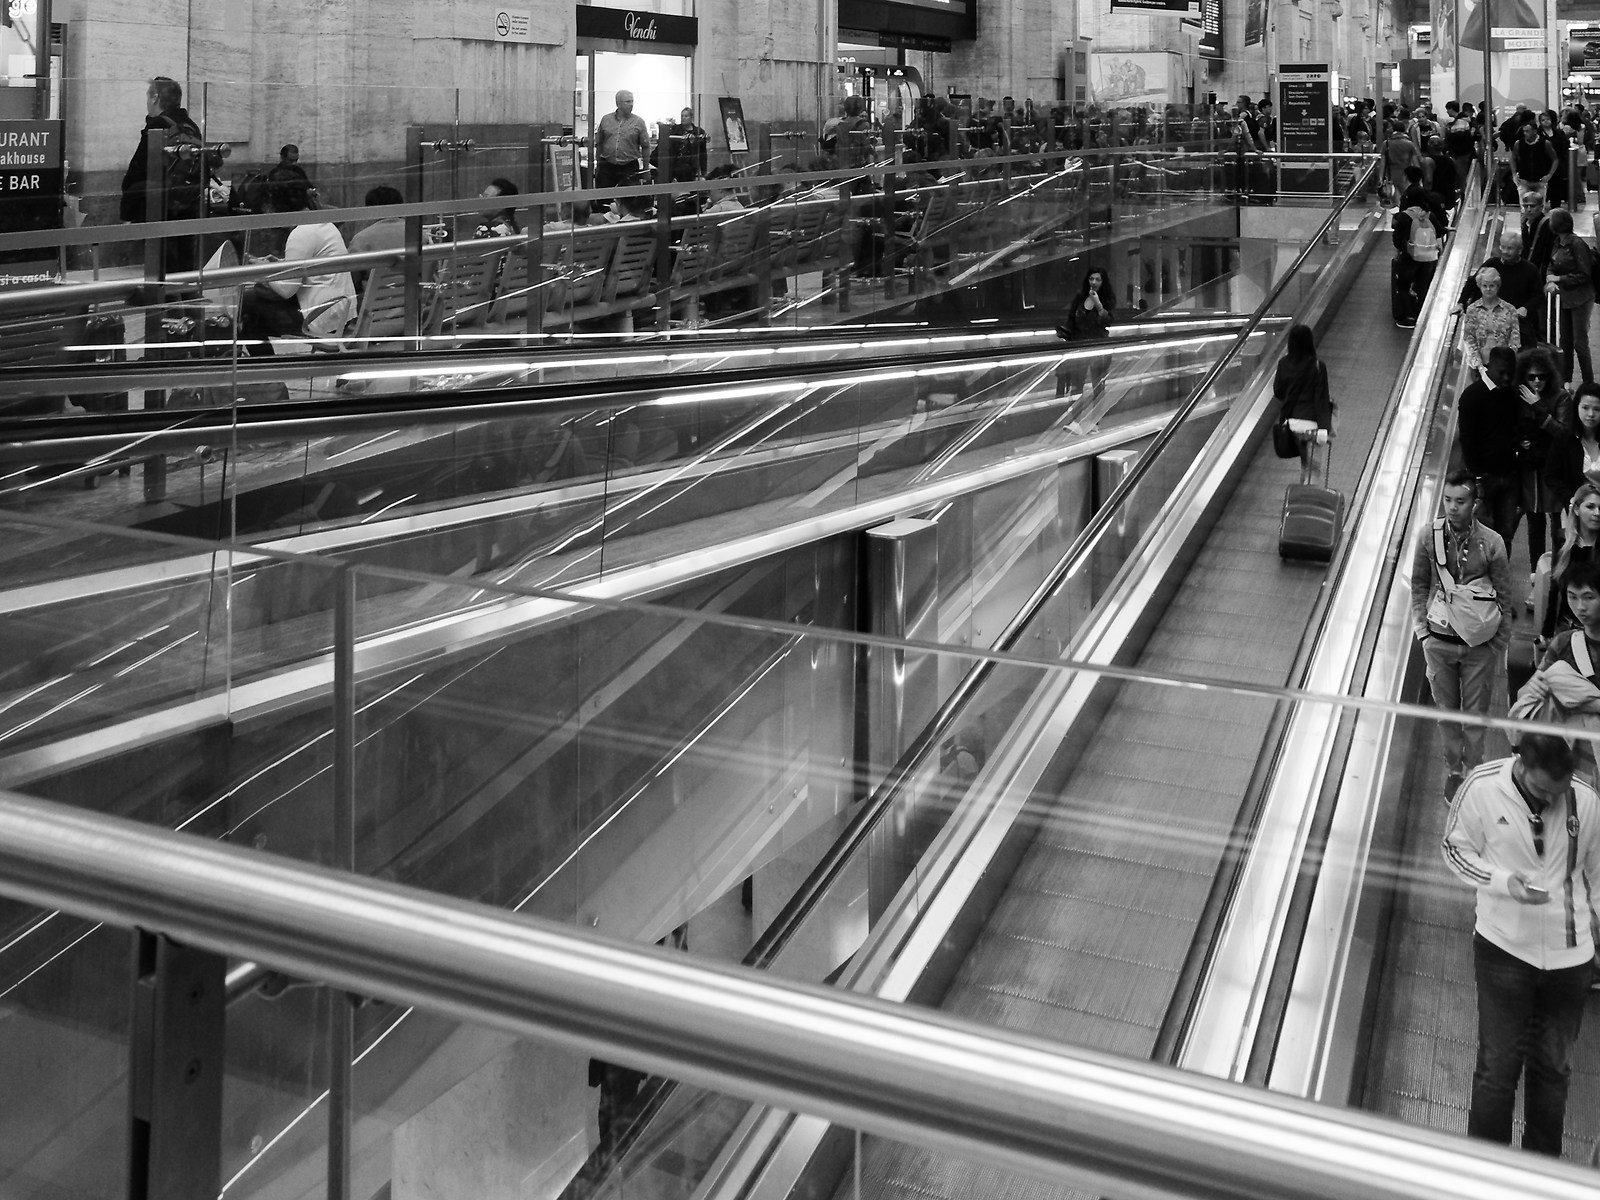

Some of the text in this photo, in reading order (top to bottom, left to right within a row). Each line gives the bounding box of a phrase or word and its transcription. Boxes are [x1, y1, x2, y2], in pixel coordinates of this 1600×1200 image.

[625, 11, 657, 40] Venchi
[0, 151, 46, 165] akhouse
[9, 174, 40, 190] BAR
[12, 276, 19, 284] a
